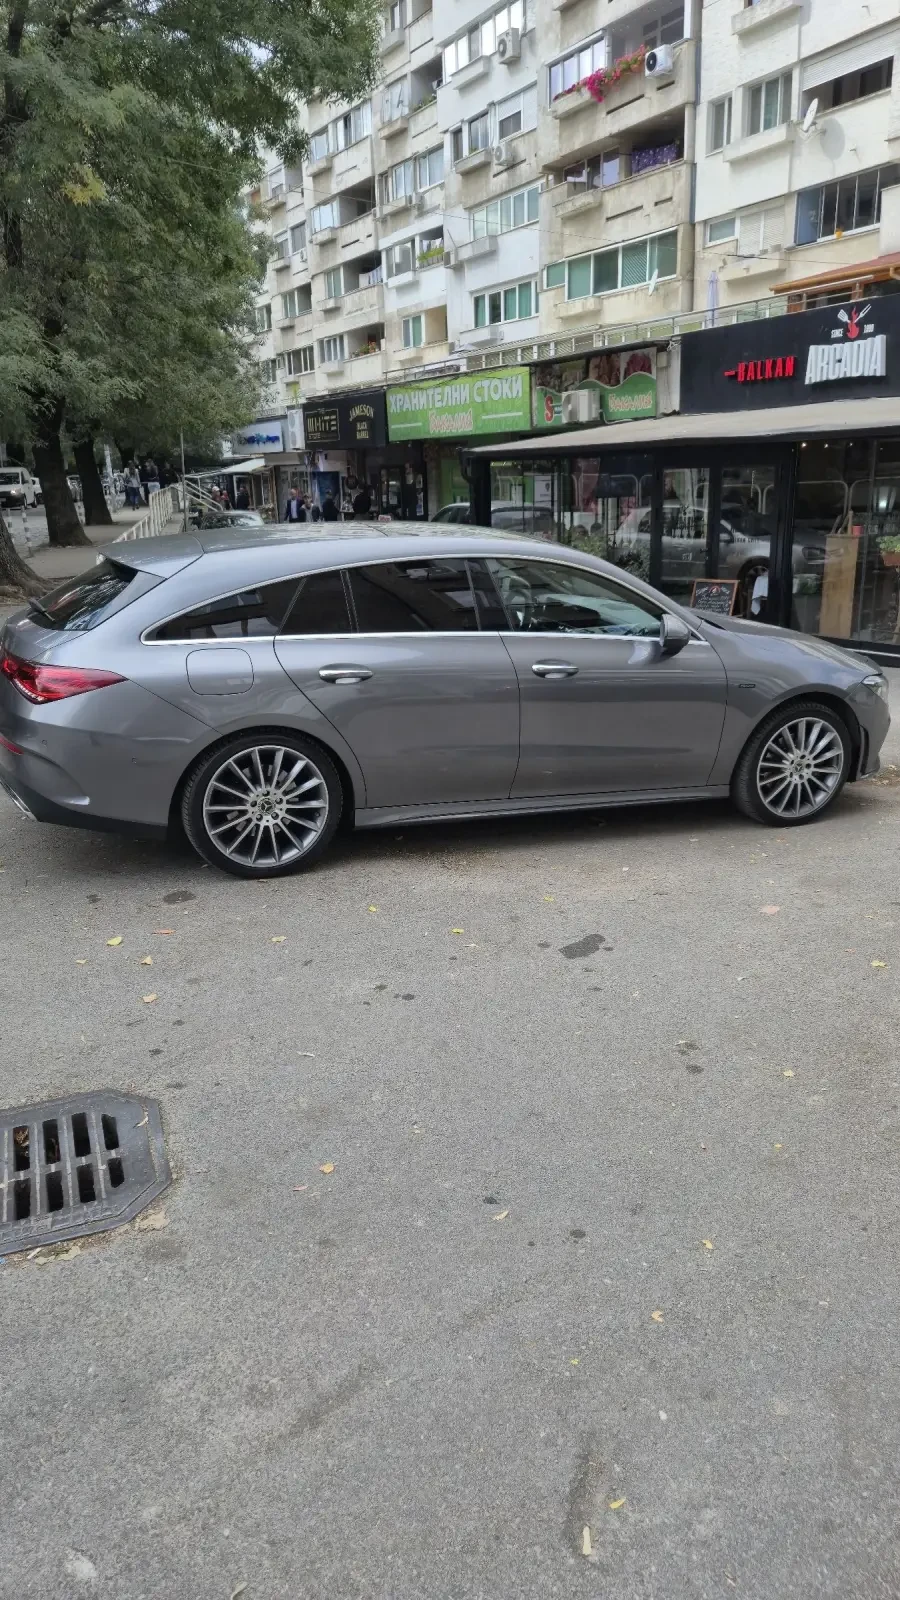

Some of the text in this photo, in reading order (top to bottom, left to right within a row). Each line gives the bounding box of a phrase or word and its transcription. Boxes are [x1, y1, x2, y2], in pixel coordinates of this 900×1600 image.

[737, 356, 795, 383] BALKAN
[804, 334, 887, 385] ARCADIA
[389, 375, 523, 413] ХРАНИТЕЛНИ СТОКИ
[349, 404, 375, 421] JAMESON
